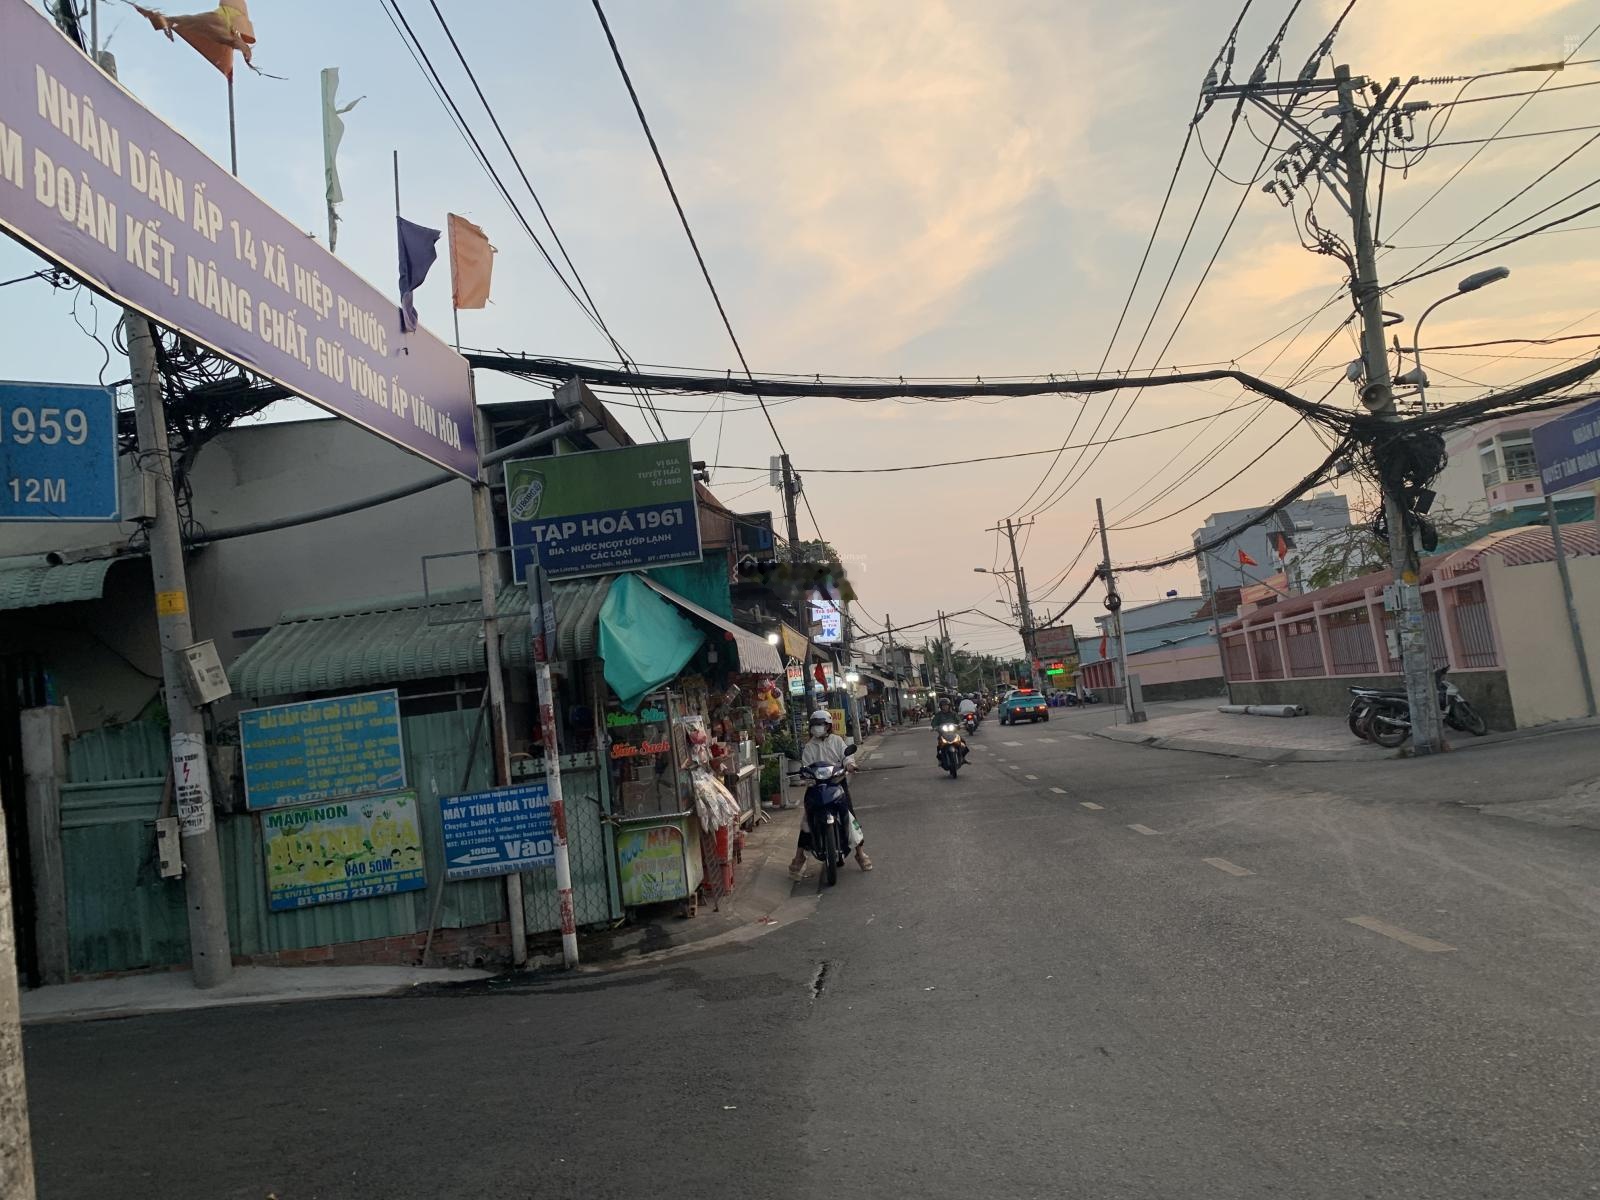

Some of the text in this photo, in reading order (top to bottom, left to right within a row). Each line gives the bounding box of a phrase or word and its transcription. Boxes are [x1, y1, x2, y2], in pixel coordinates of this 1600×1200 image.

[36, 63, 387, 358] NHÂN DÂN ẤP 14 XÃ HIỆP PHƯỚC
[34, 147, 117, 253] ĐOÀN
[126, 213, 180, 296] KẾT,
[187, 254, 252, 333] NÂNG
[259, 301, 312, 370] CHẤT,
[315, 336, 346, 384] GIỮ
[348, 355, 389, 409] VỮNG
[391, 375, 409, 419] ẤP
[411, 394, 437, 437] VĂN
[438, 412, 462, 451] HÓA
[0, 407, 88, 445] 959
[9, 478, 66, 503] 12M
[511, 484, 539, 517] TUBORG
[531, 507, 684, 547] TẠP HOÁ 1961
[548, 547, 565, 557] BIA
[599, 540, 623, 552] NGỌT
[646, 533, 672, 545] LẠNH
[610, 547, 632, 559] LOẠI
[312, 804, 348, 822] NON
[469, 802, 494, 817] TÍNH
[470, 847, 497, 856] 100m
[504, 839, 553, 859] Vào
[369, 858, 393, 872] 50M
[351, 885, 375, 897] 237
